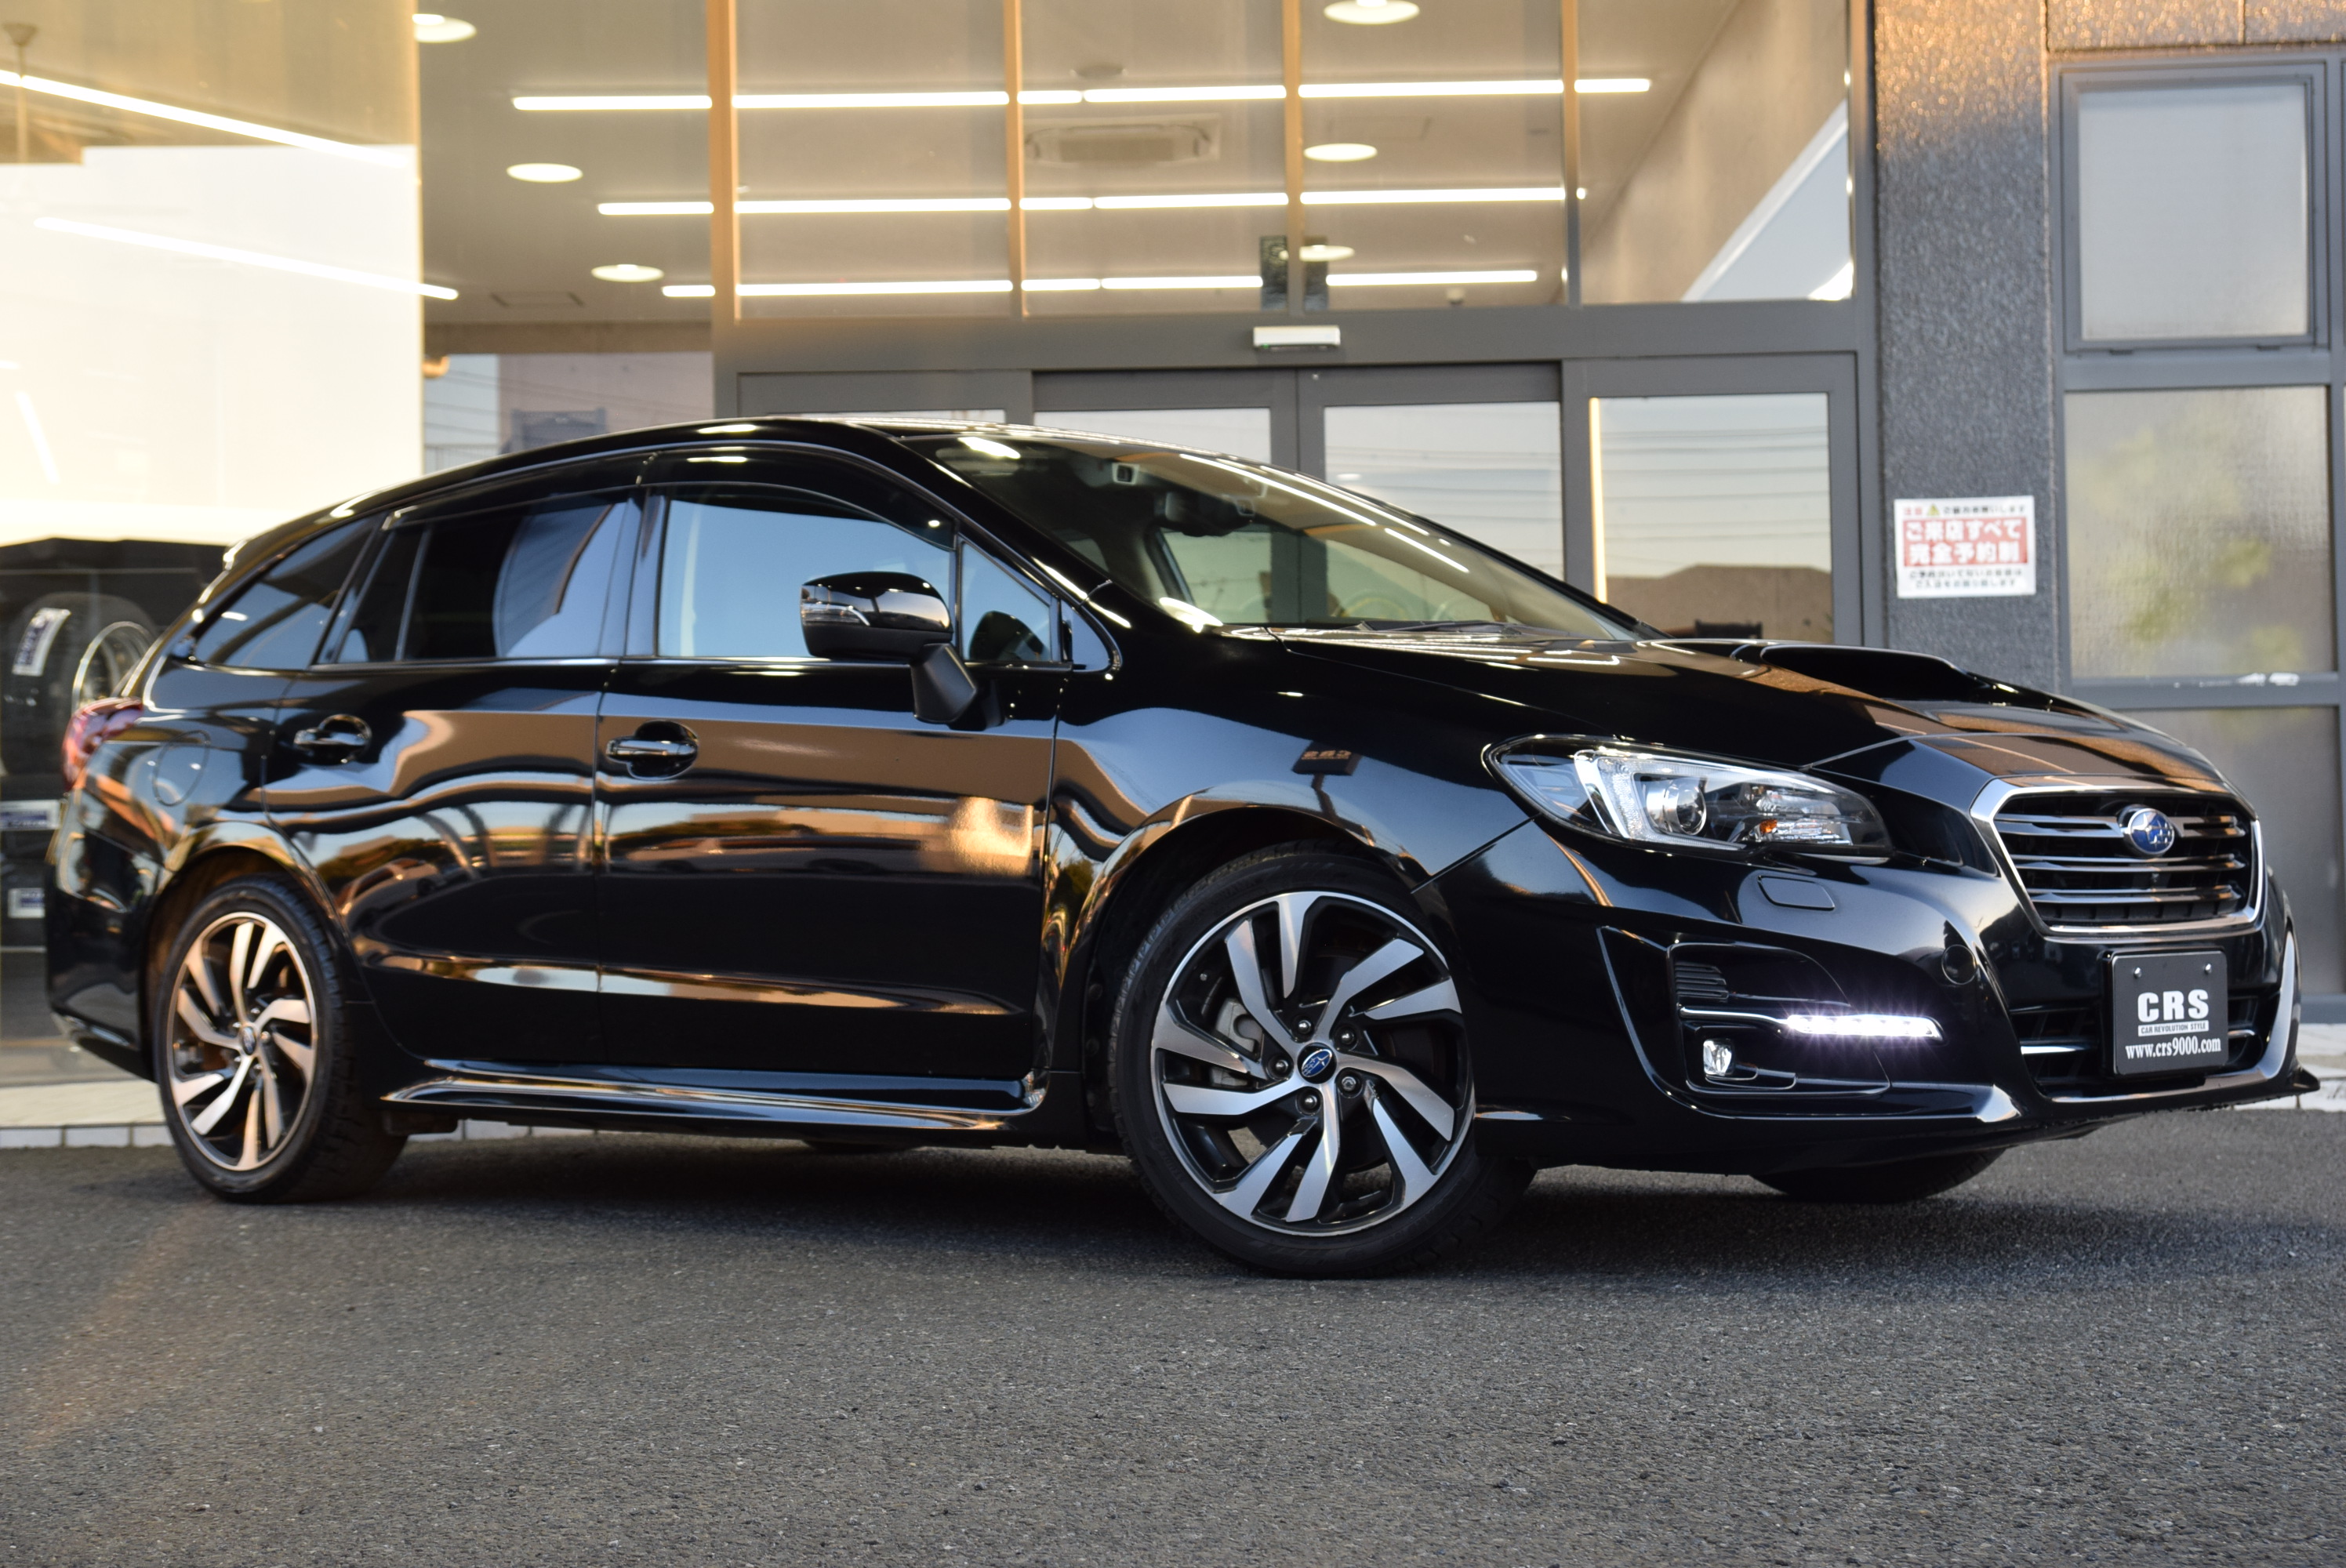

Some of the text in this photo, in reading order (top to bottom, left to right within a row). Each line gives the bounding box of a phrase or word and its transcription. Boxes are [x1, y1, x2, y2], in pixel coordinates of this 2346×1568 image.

[2137, 989, 2209, 1022] CRS
[2141, 1022, 2206, 1034] CAR REVOLUTION STYLE
[2125, 1036, 2221, 1059] www.crs9000.com
